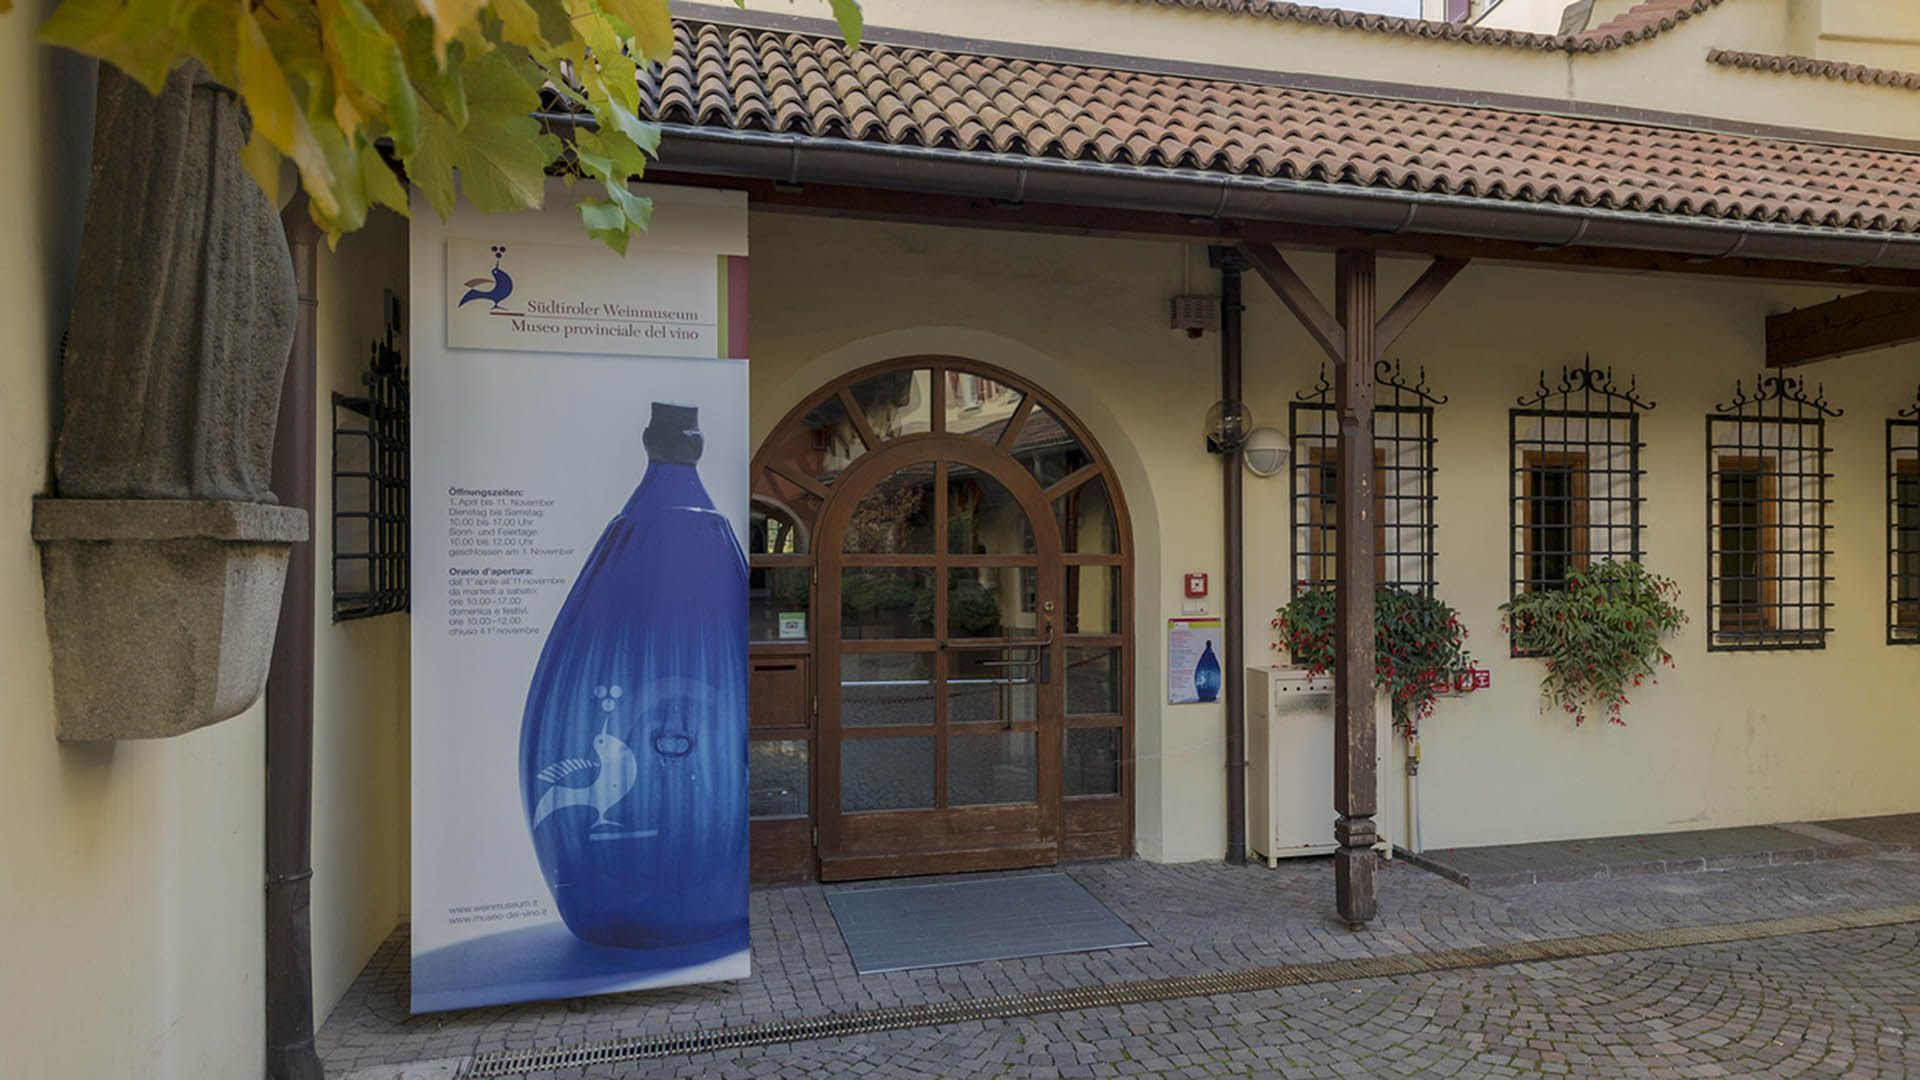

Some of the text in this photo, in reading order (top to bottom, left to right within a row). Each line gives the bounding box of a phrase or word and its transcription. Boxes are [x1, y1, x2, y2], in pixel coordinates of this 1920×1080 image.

[527, 299, 699, 321] Südtiroler Weinmuseum
[511, 320, 699, 341] Museo provinciale del vino
[448, 486, 524, 497] Öffnungszeiten:
[459, 499, 479, 507] April
[448, 509, 487, 517] Dienstag
[449, 518, 473, 526] 10.00
[476, 518, 489, 526] bis
[518, 518, 534, 526] Uhr
[448, 528, 475, 536] Sonn-
[478, 528, 495, 536] und
[449, 538, 473, 546] 10.00
[492, 538, 516, 546] 12.00
[518, 538, 534, 546] Uhr
[448, 548, 504, 557] geschlossen
[449, 567, 480, 575] Orario
[449, 578, 463, 586] dal
[475, 578, 498, 586] aprile
[449, 608, 492, 616] domenica
[449, 628, 478, 636] chiuso
[448, 900, 538, 914] www.weinmuseum.it
[449, 909, 548, 924] www.museo-del-vino.it
